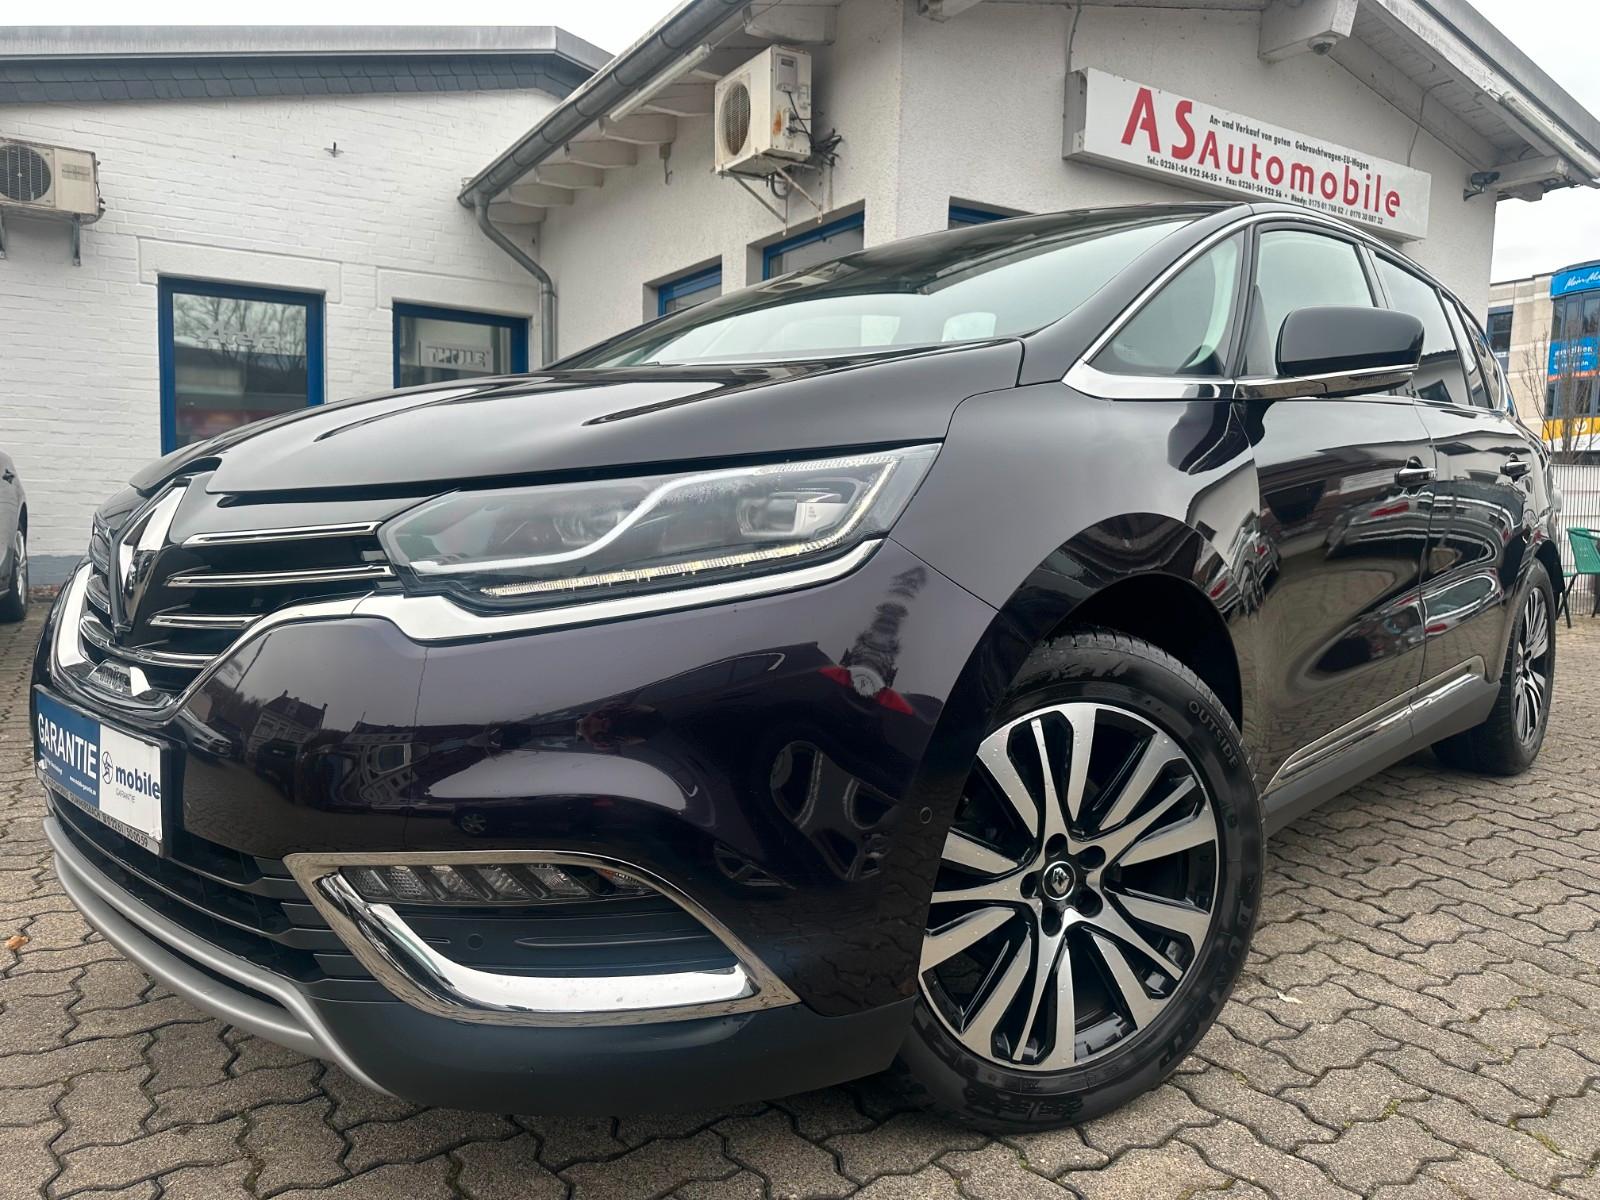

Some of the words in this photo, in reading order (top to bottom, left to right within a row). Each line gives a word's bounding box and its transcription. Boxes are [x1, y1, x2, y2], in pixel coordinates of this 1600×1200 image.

[1209, 115, 1220, 125] An-
[1222, 121, 1234, 130] und
[1236, 122, 1260, 138] Verkauf
[1261, 132, 1272, 141] von
[1273, 136, 1291, 147] guten
[1147, 155, 1159, 166] Tel.:
[1160, 159, 1188, 174] 02261-54
[1190, 167, 1201, 178] 922
[1202, 170, 1217, 182] 54-55
[1226, 176, 1238, 186] Fax:
[1238, 179, 1263, 192] 02261-54
[38, 712, 97, 780] GARANTIE
[1189, 700, 1239, 768] OUTSIDE
[115, 766, 161, 800] mobile
